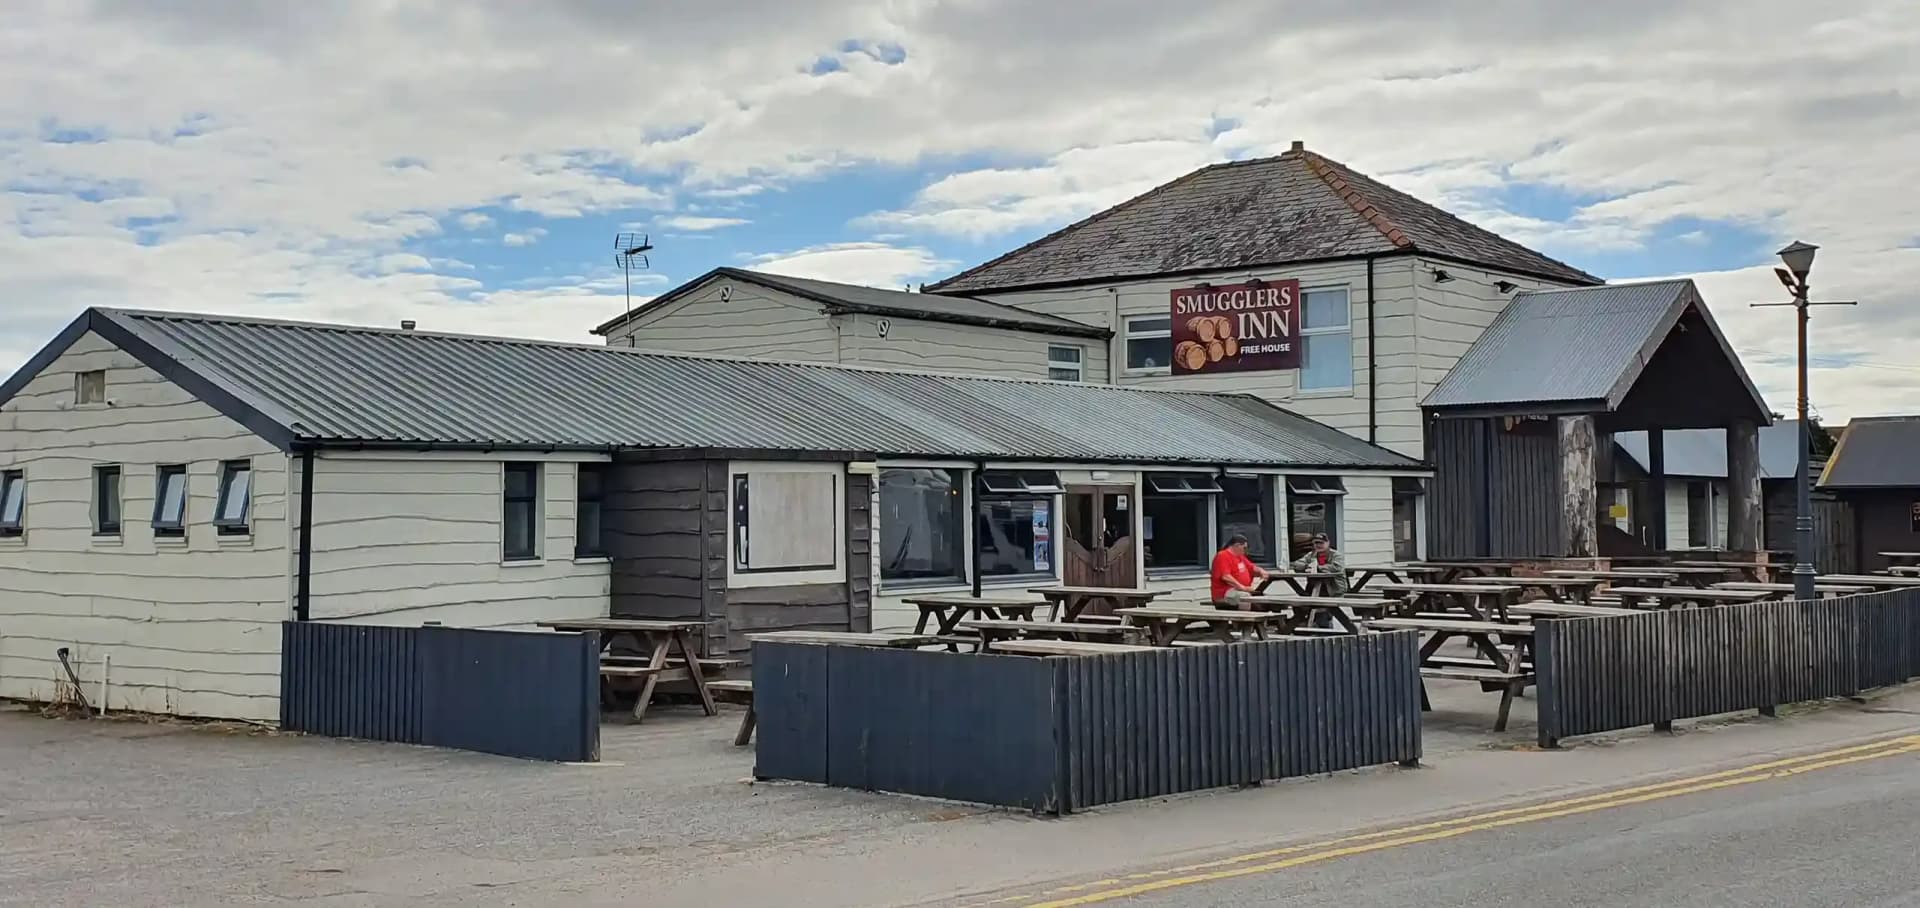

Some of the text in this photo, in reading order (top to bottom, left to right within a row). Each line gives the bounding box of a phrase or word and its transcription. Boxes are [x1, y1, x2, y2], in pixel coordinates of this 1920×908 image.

[1176, 287, 1291, 314] SMUGGLERS
[1237, 309, 1292, 340] INN
[1240, 343, 1291, 354] FREE HOUSE
